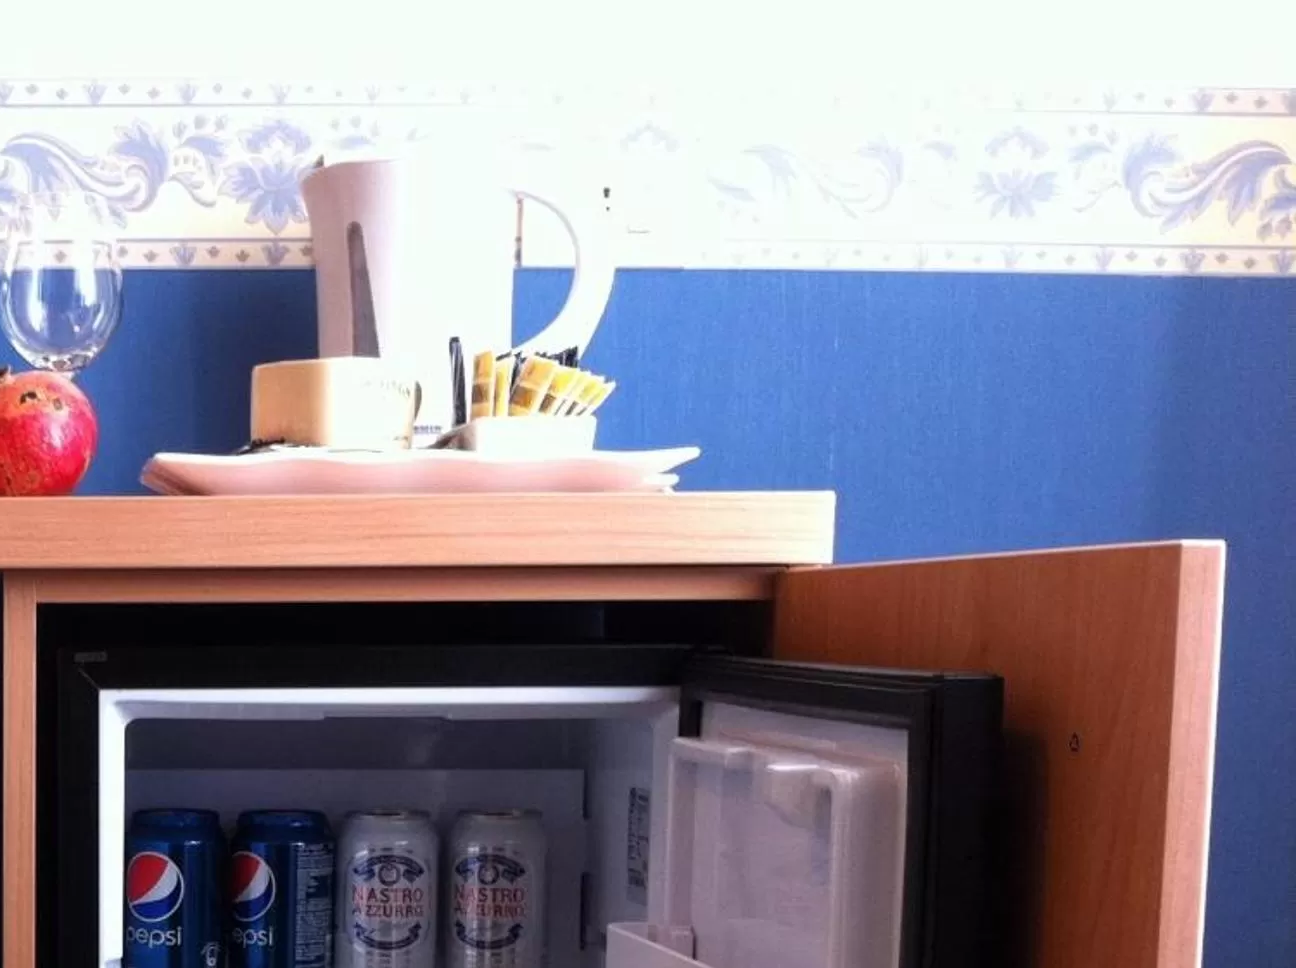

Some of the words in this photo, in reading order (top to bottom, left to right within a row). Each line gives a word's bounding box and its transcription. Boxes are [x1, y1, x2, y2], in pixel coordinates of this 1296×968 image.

[352, 885, 424, 904] NASTRO
[454, 884, 526, 904] NASTRO
[231, 925, 275, 949] epsi
